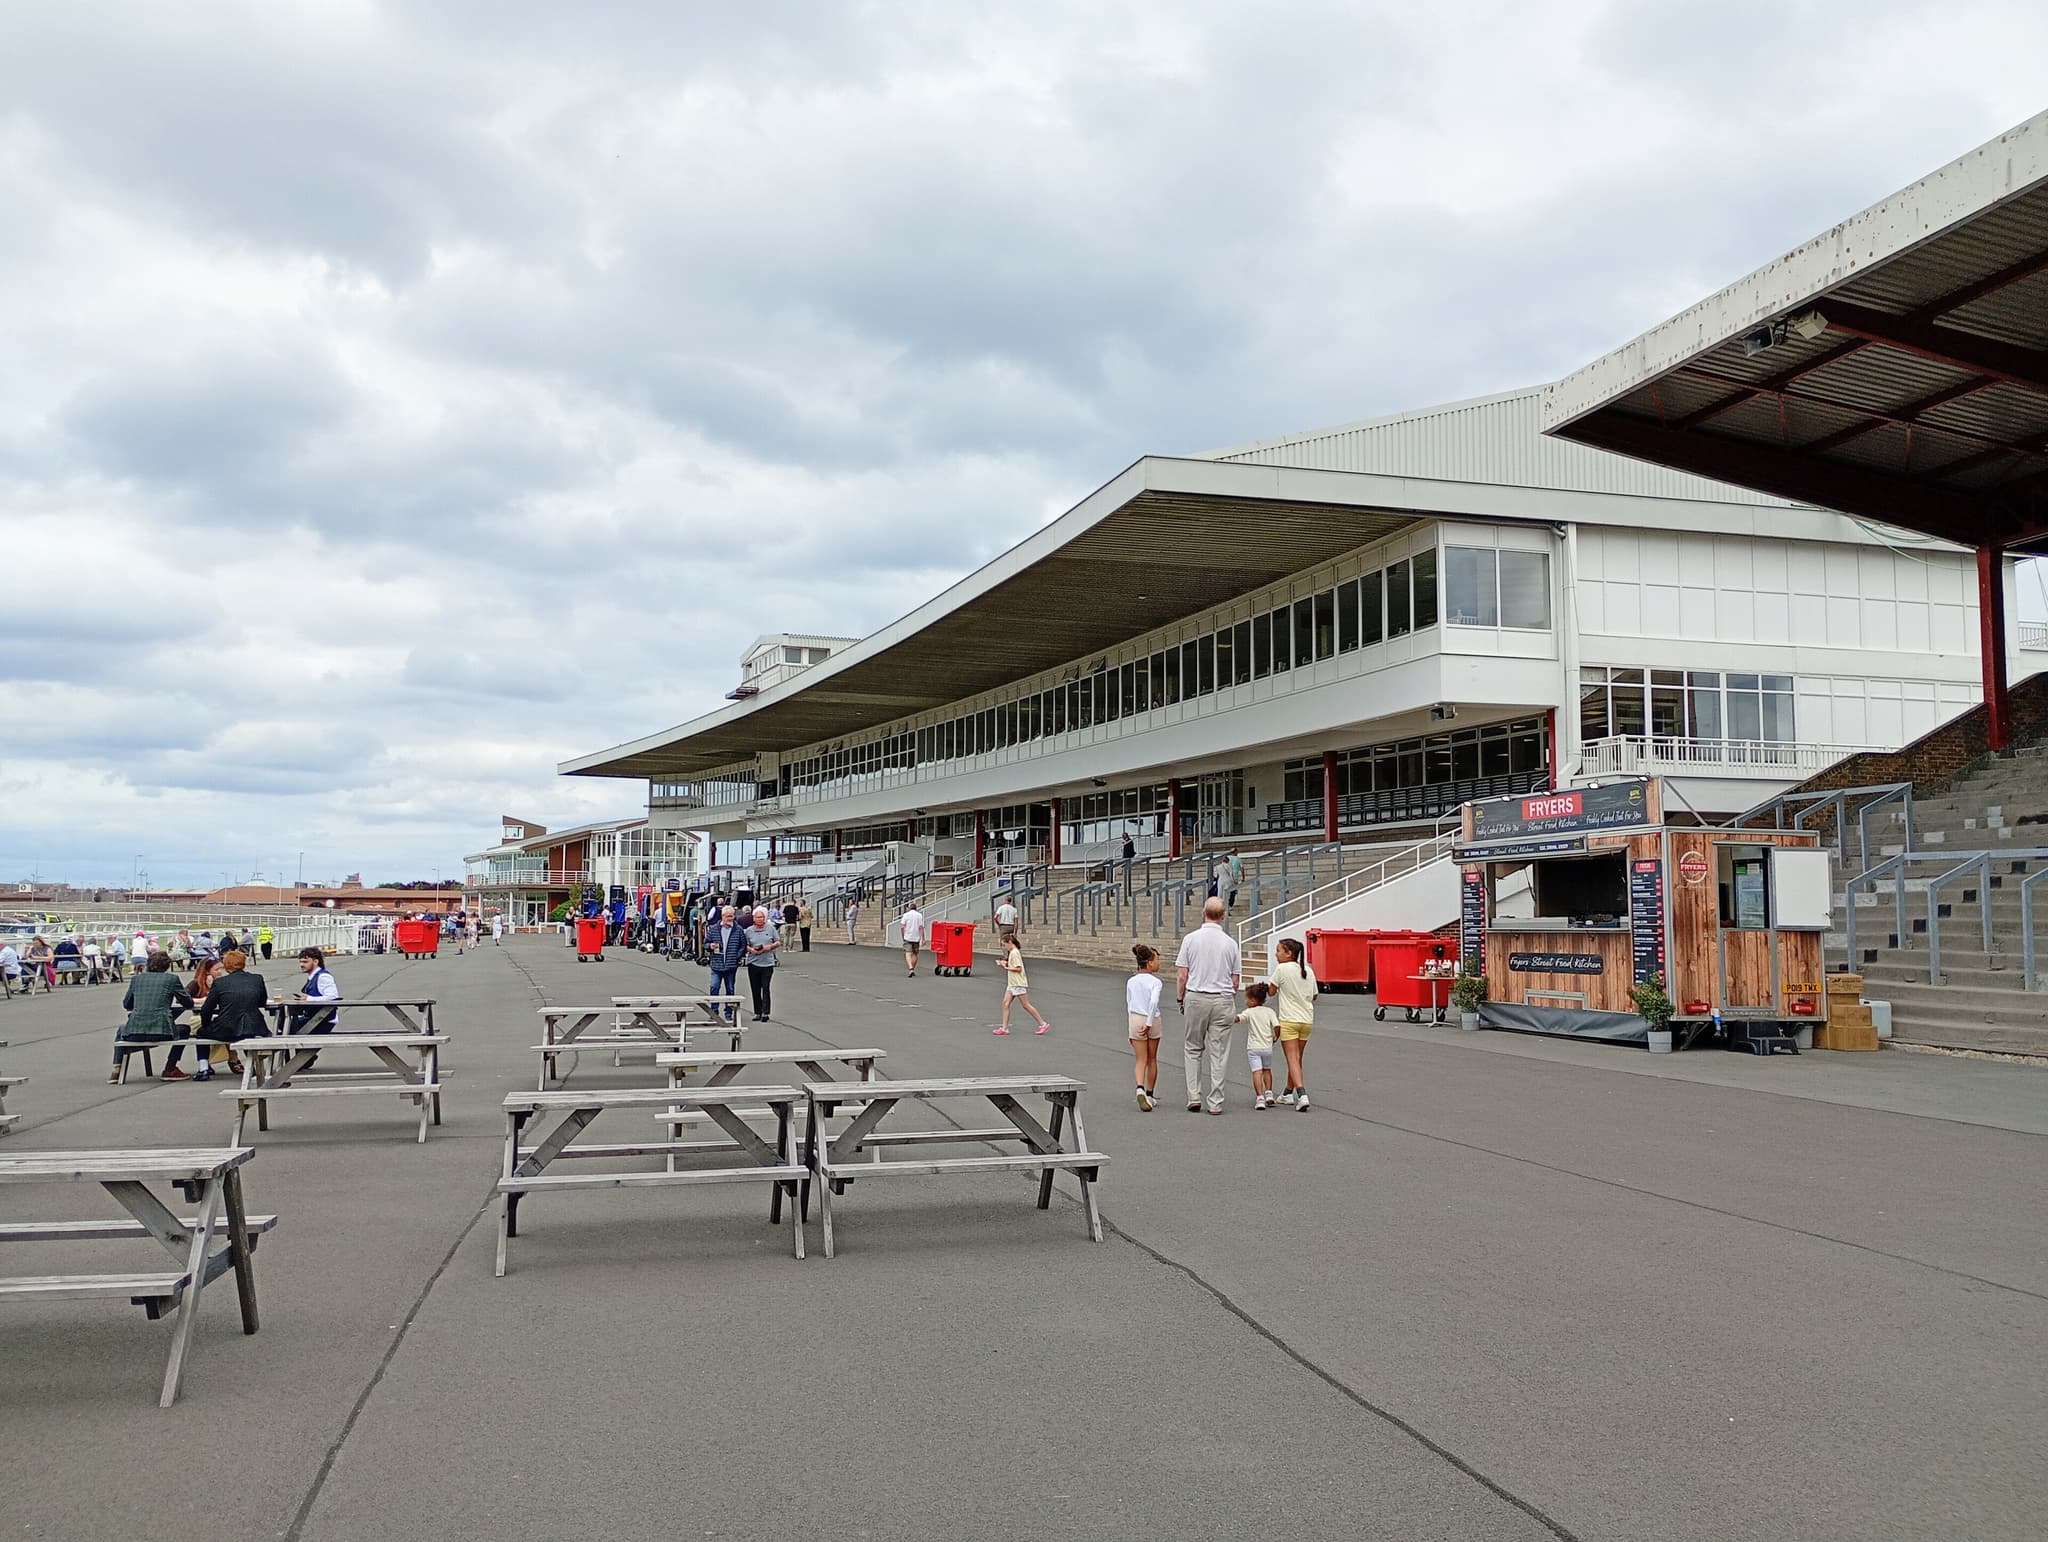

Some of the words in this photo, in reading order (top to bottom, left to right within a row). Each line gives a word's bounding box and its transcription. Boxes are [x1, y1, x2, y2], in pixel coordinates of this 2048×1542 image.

[1529, 797, 1574, 817] FRYERS
[1527, 821, 1544, 832] Street
[1545, 818, 1558, 830] Food
[1558, 816, 1578, 828] Kitchen
[1508, 846, 1519, 854] Food
[1510, 956, 1529, 969] Fryers
[1531, 956, 1553, 967] Street
[1555, 957, 1573, 969] Food
[1574, 957, 1602, 969] Kitchen
